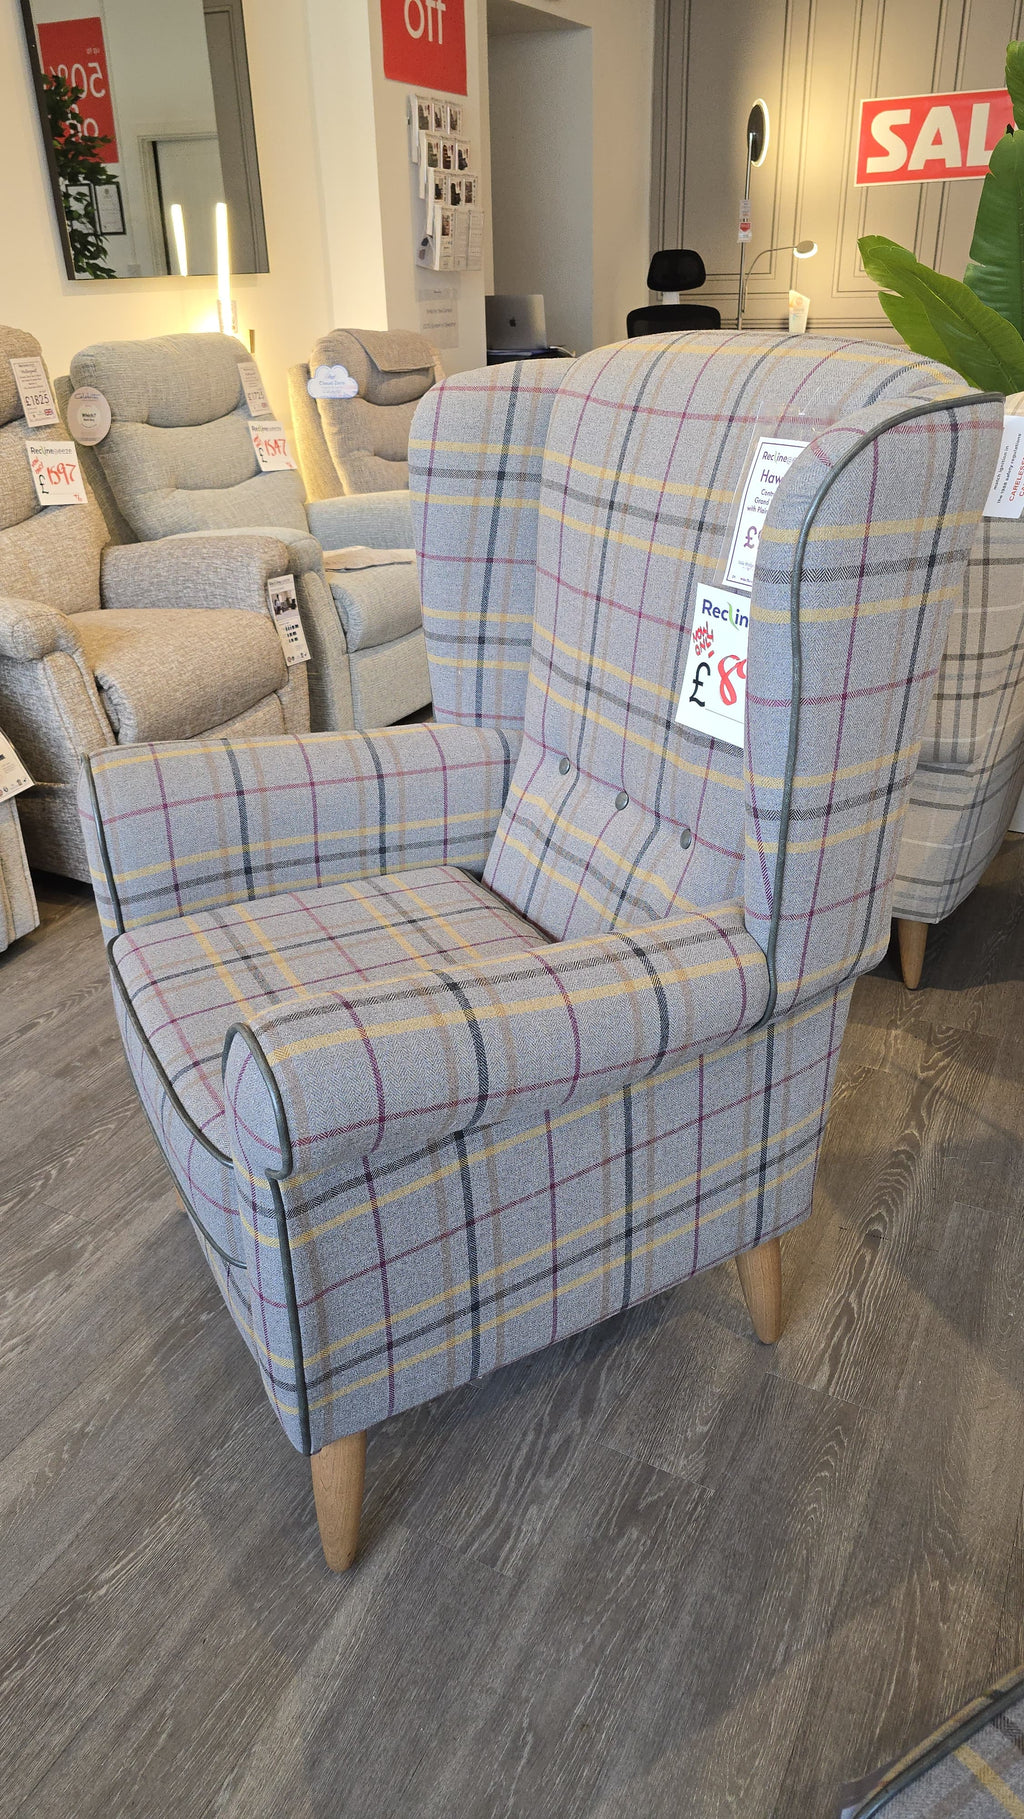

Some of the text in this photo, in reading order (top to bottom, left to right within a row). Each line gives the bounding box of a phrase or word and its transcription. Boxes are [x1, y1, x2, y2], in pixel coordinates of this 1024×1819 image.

[866, 102, 993, 174] SAL
[25, 394, 50, 406] £1825
[760, 469, 782, 484] Haw
[702, 599, 749, 631] Reclin
